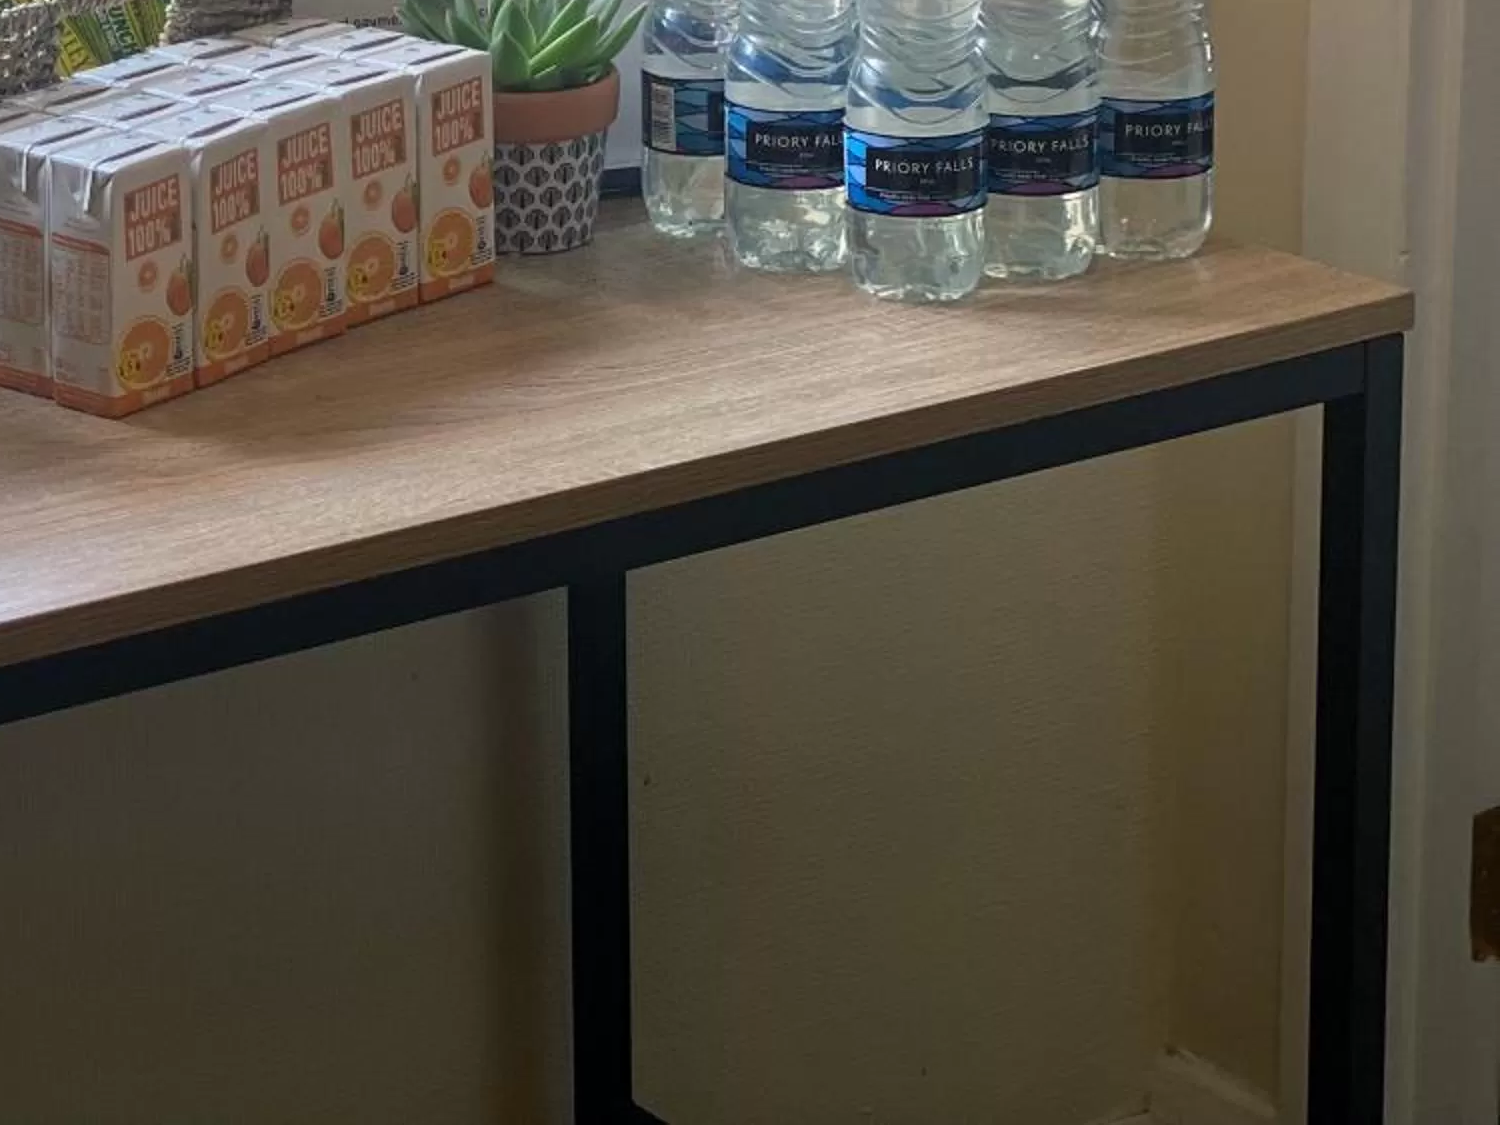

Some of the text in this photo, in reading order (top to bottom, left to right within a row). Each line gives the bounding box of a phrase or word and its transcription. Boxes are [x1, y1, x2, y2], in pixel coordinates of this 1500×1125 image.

[436, 81, 481, 120] JUICE
[356, 102, 402, 144] JUICE
[435, 116, 473, 151] 100%
[754, 132, 844, 148] PRIORY FAL
[1125, 123, 1182, 138] PRIORY
[281, 126, 329, 168] JUICE
[355, 138, 395, 175] 100%
[988, 134, 1090, 154] PRIORY FALLS
[216, 152, 257, 195] JUICE
[280, 161, 323, 200] 100%
[875, 157, 973, 174] PRIORY FALLS
[130, 178, 179, 222] JUICE
[213, 190, 250, 230] 100%
[128, 215, 172, 256] 100%
